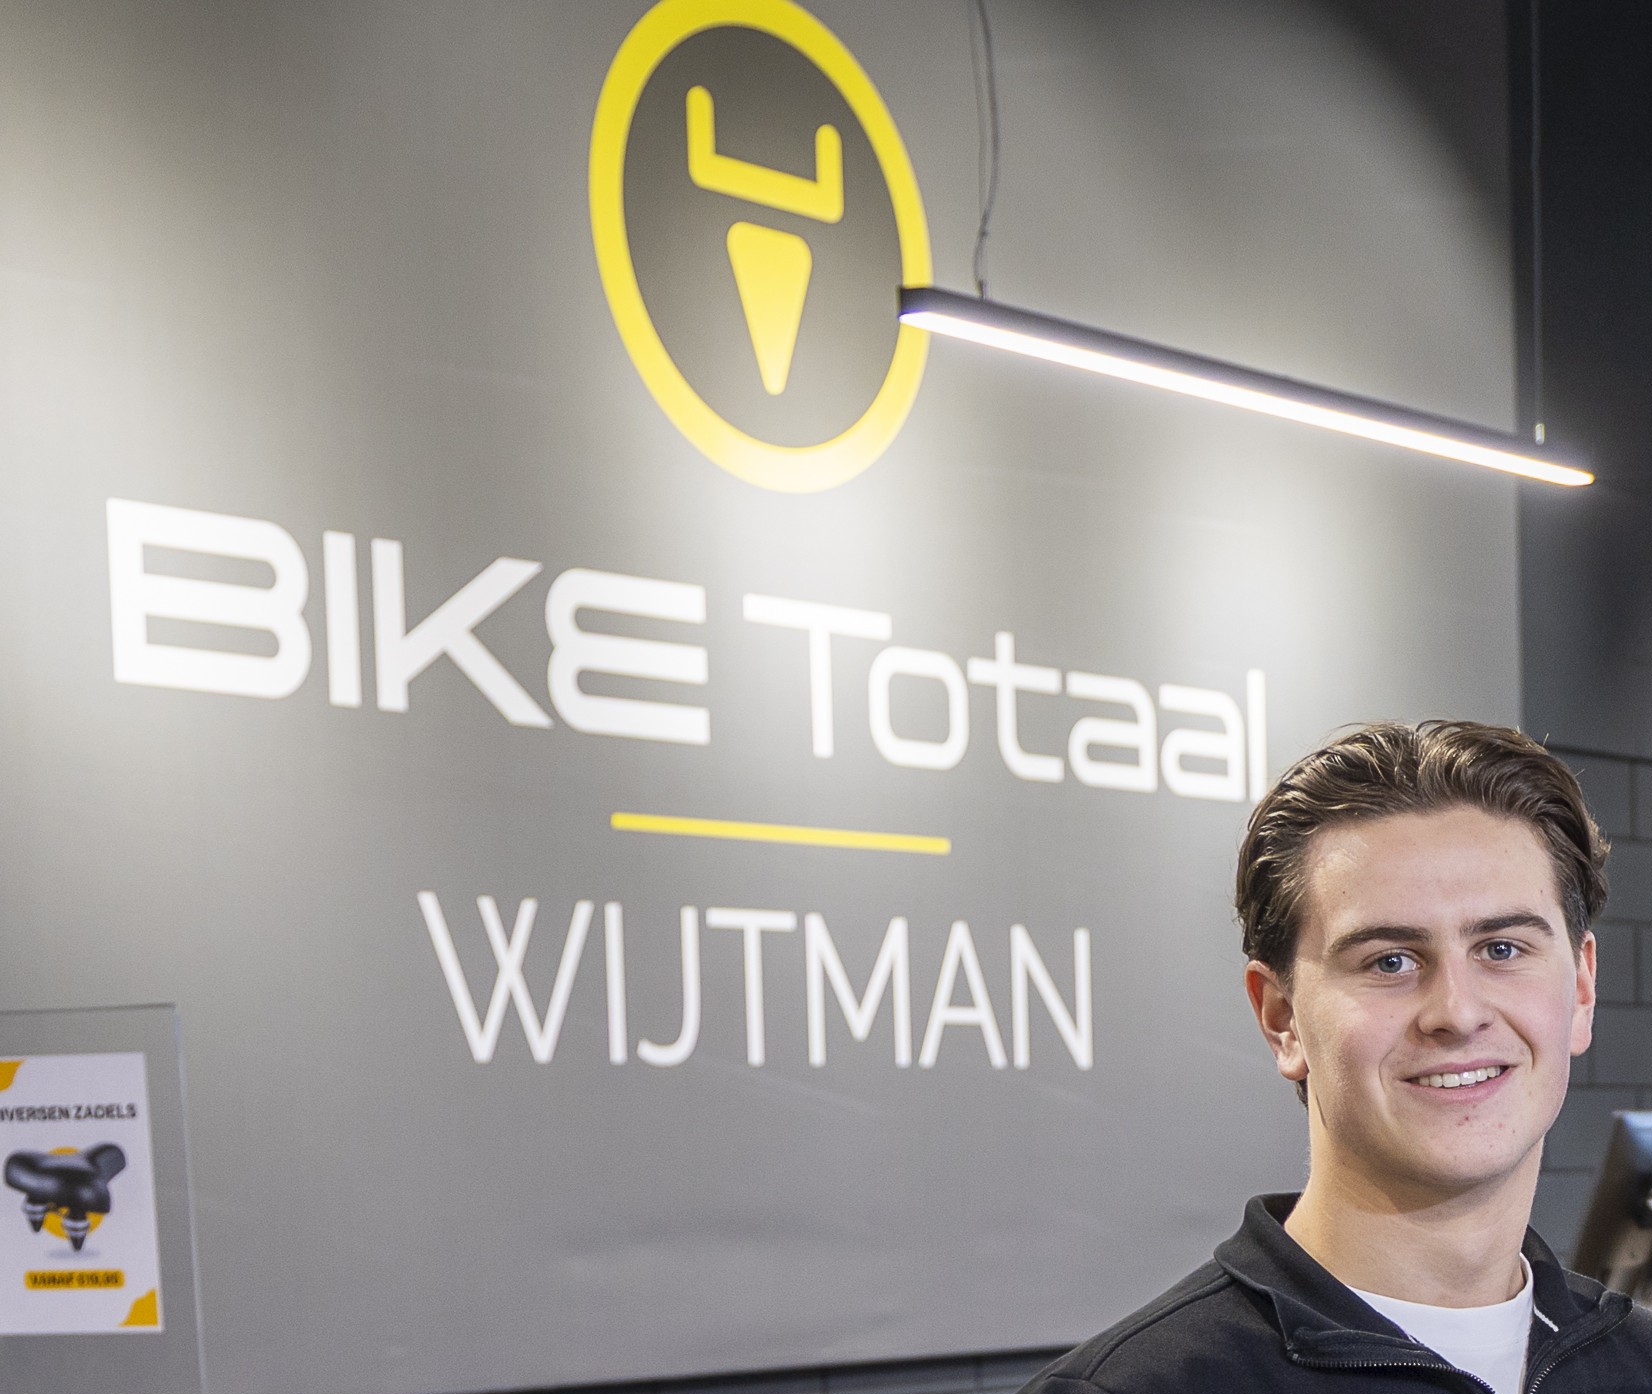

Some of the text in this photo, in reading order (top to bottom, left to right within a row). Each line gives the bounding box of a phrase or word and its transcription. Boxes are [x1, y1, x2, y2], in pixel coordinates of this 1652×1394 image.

[106, 496, 1268, 802] BIKE Totaal
[417, 890, 1095, 1071] WIJTMAN
